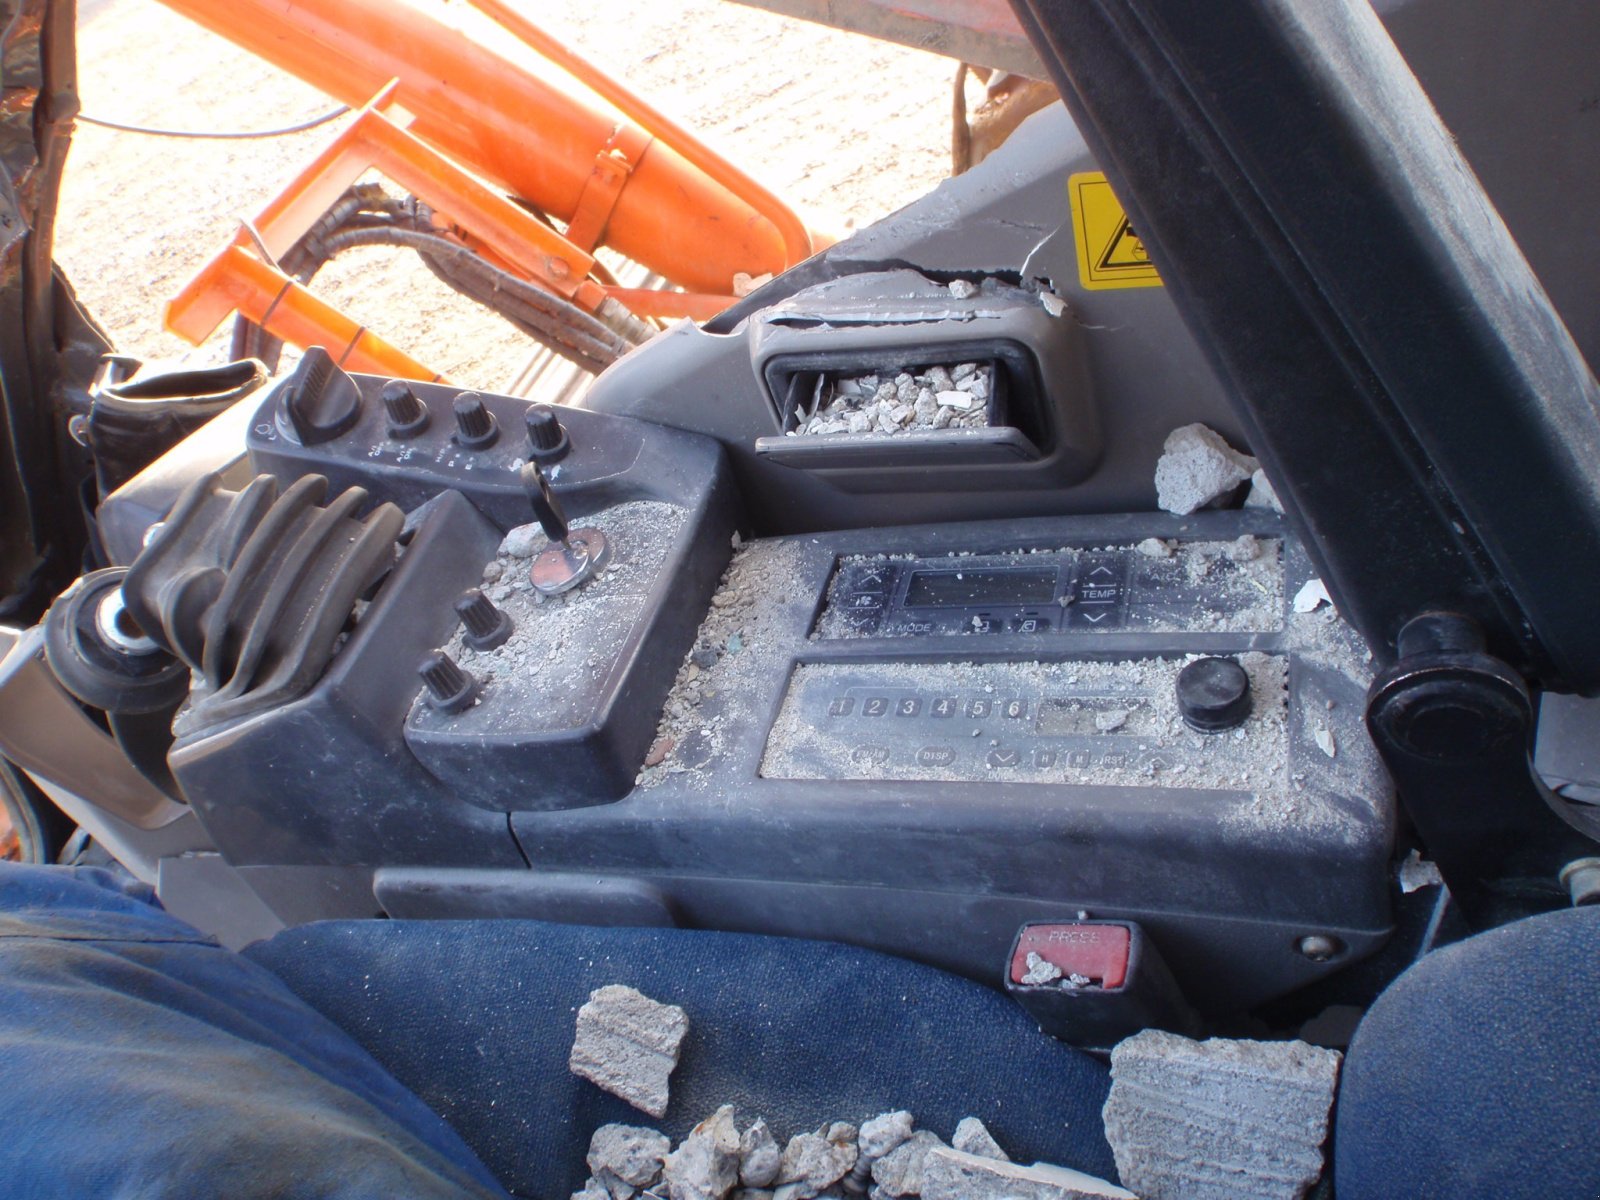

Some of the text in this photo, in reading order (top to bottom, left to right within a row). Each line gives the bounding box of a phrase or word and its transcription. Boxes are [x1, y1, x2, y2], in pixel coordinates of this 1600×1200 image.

[1081, 589, 1116, 599] TEMP
[898, 623, 932, 633] MODE
[868, 700, 881, 714] 2
[902, 700, 915, 714] 3
[937, 700, 948, 715] 4
[972, 701, 985, 715] 5
[1008, 701, 1020, 717] 6
[923, 752, 949, 760] DISP
[1041, 755, 1049, 763] H
[1075, 755, 1084, 763] M
